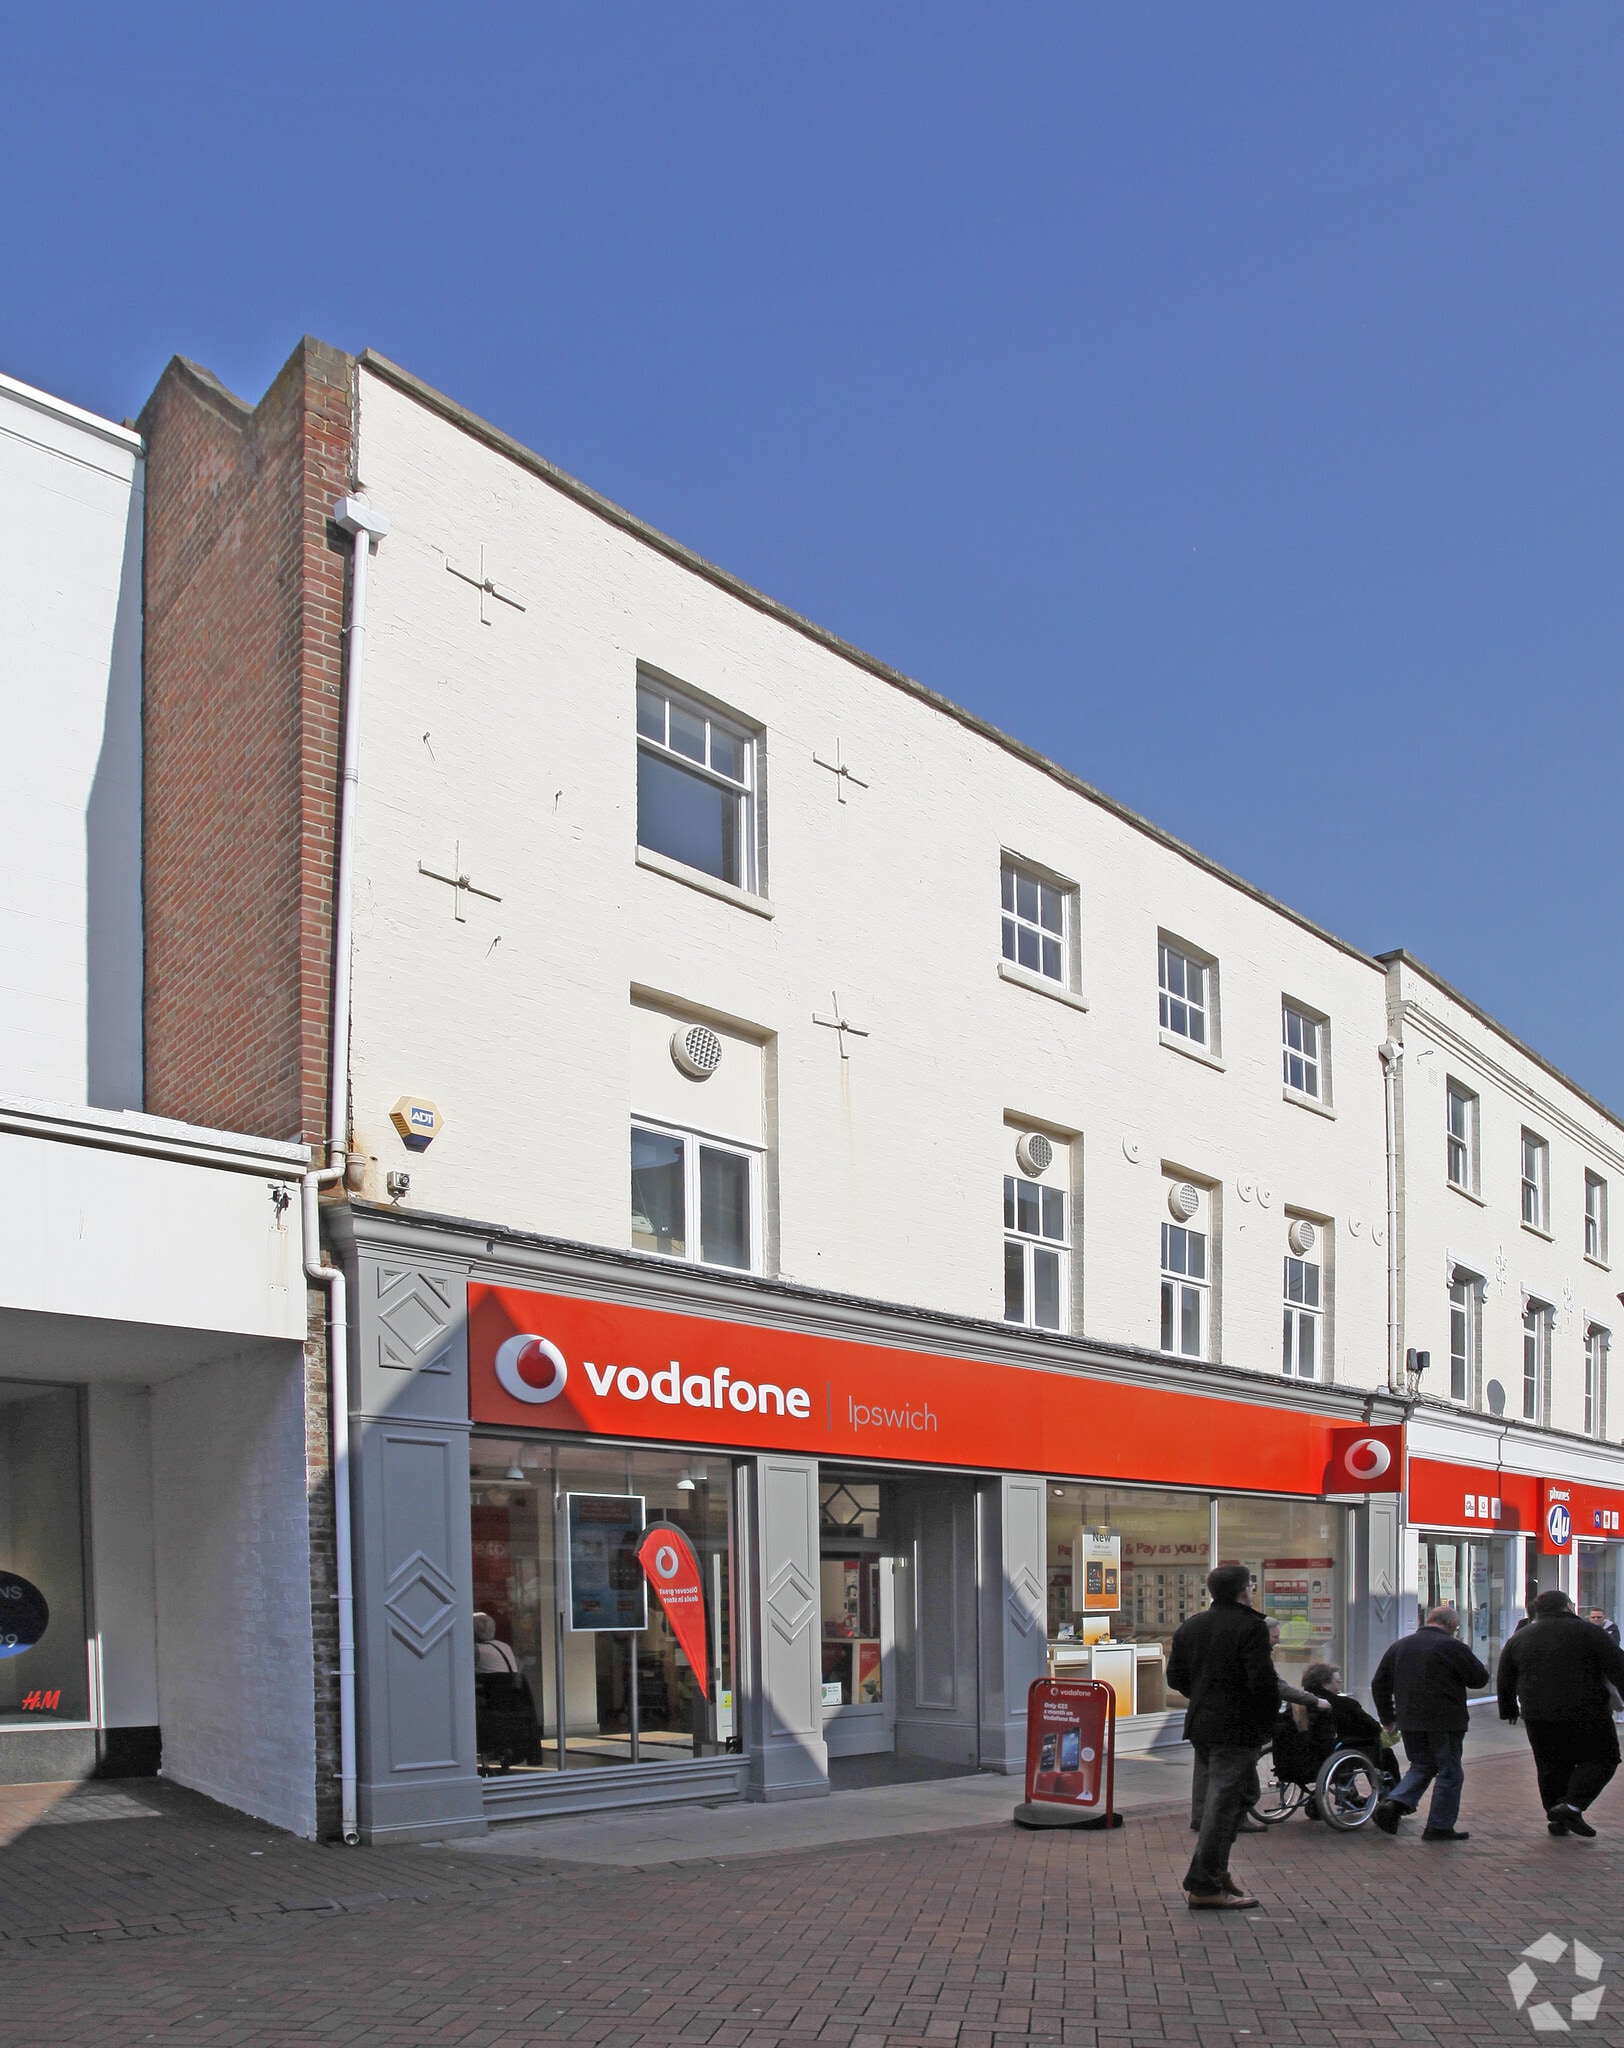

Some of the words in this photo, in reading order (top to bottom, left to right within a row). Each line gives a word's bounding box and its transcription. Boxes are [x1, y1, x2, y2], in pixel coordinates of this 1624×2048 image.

[412, 1111, 434, 1124] ADT
[583, 1360, 811, 1418] vodafone
[848, 1395, 938, 1432] Ipswich
[1549, 1486, 1570, 1502] phones
[1551, 1507, 1570, 1544] 4u
[1092, 1532, 1111, 1542] New
[1136, 1542, 1157, 1557] Pay
[1159, 1544, 1172, 1554] as
[1174, 1544, 1197, 1556] you
[22, 1690, 61, 1710] H&M
